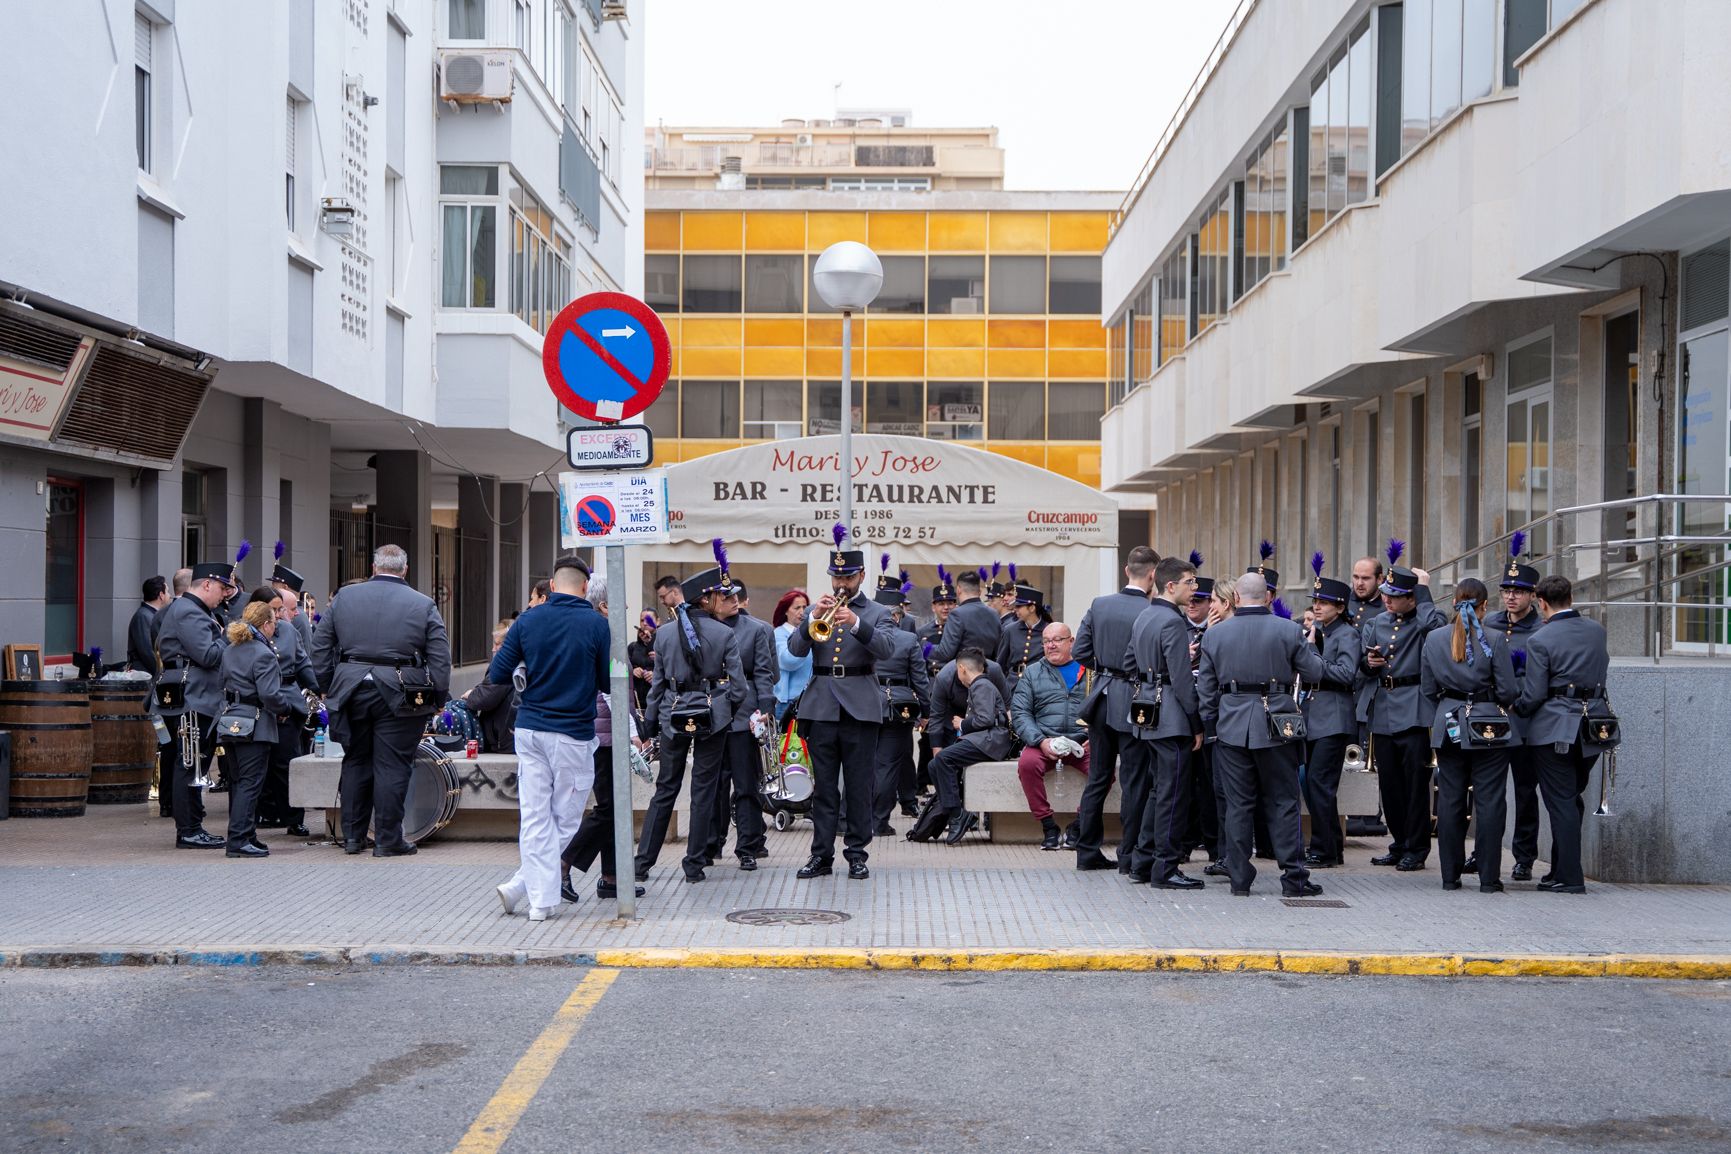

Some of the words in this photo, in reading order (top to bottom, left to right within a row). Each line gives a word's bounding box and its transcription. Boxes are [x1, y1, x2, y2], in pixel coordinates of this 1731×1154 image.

[14, 387, 48, 414] Jose
[772, 448, 841, 472] Mari
[850, 455, 868, 478] y
[871, 450, 941, 477] Jose
[642, 488, 653, 496] 24
[713, 481, 767, 501] BAR
[800, 483, 996, 504] RETAURANTE
[630, 513, 651, 522] MES
[815, 509, 858, 520] DESE
[864, 509, 893, 520] 1986
[1027, 510, 1098, 526] Cruzcampo
[579, 528, 611, 537] SANTA
[619, 525, 657, 533] MARZO
[774, 523, 825, 538] tlfno:
[867, 526, 886, 538] 28
[893, 526, 912, 539] 72
[918, 526, 936, 539] 57
